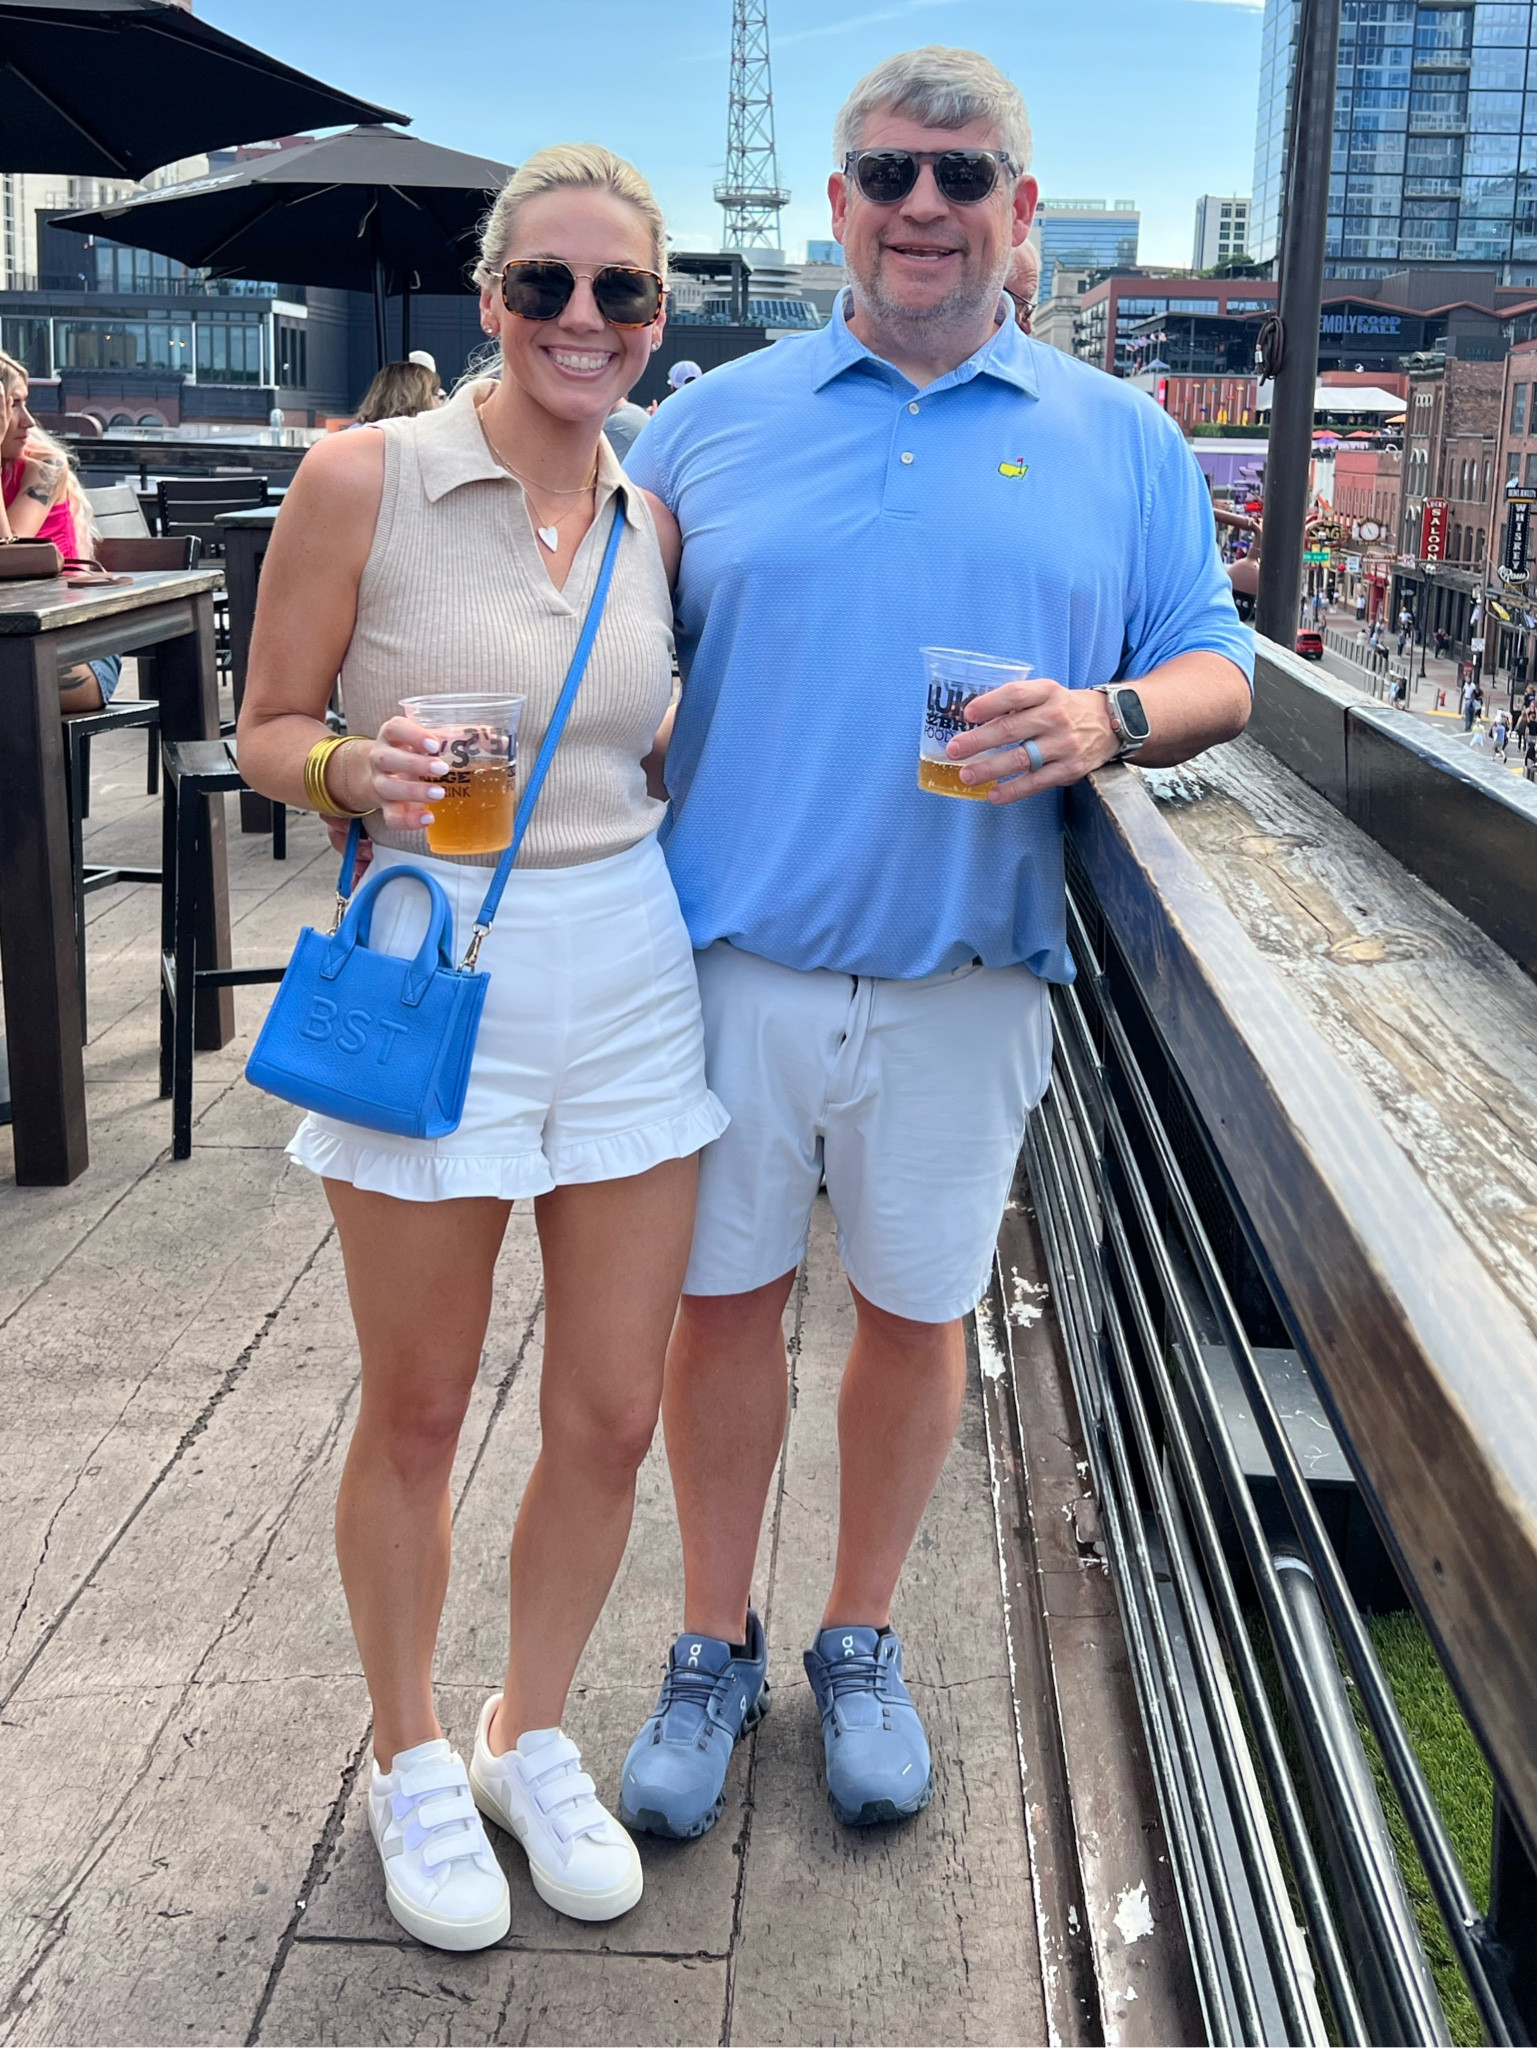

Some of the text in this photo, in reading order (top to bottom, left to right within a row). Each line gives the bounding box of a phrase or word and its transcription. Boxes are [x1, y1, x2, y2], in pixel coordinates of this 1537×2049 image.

[1357, 315, 1401, 325] FOOD
[1357, 324, 1400, 334] HALL
[1427, 508, 1441, 560] SALOON
[1512, 503, 1527, 570] WHISKEY
[927, 684, 978, 718] LUK
[300, 995, 408, 1065] BST
